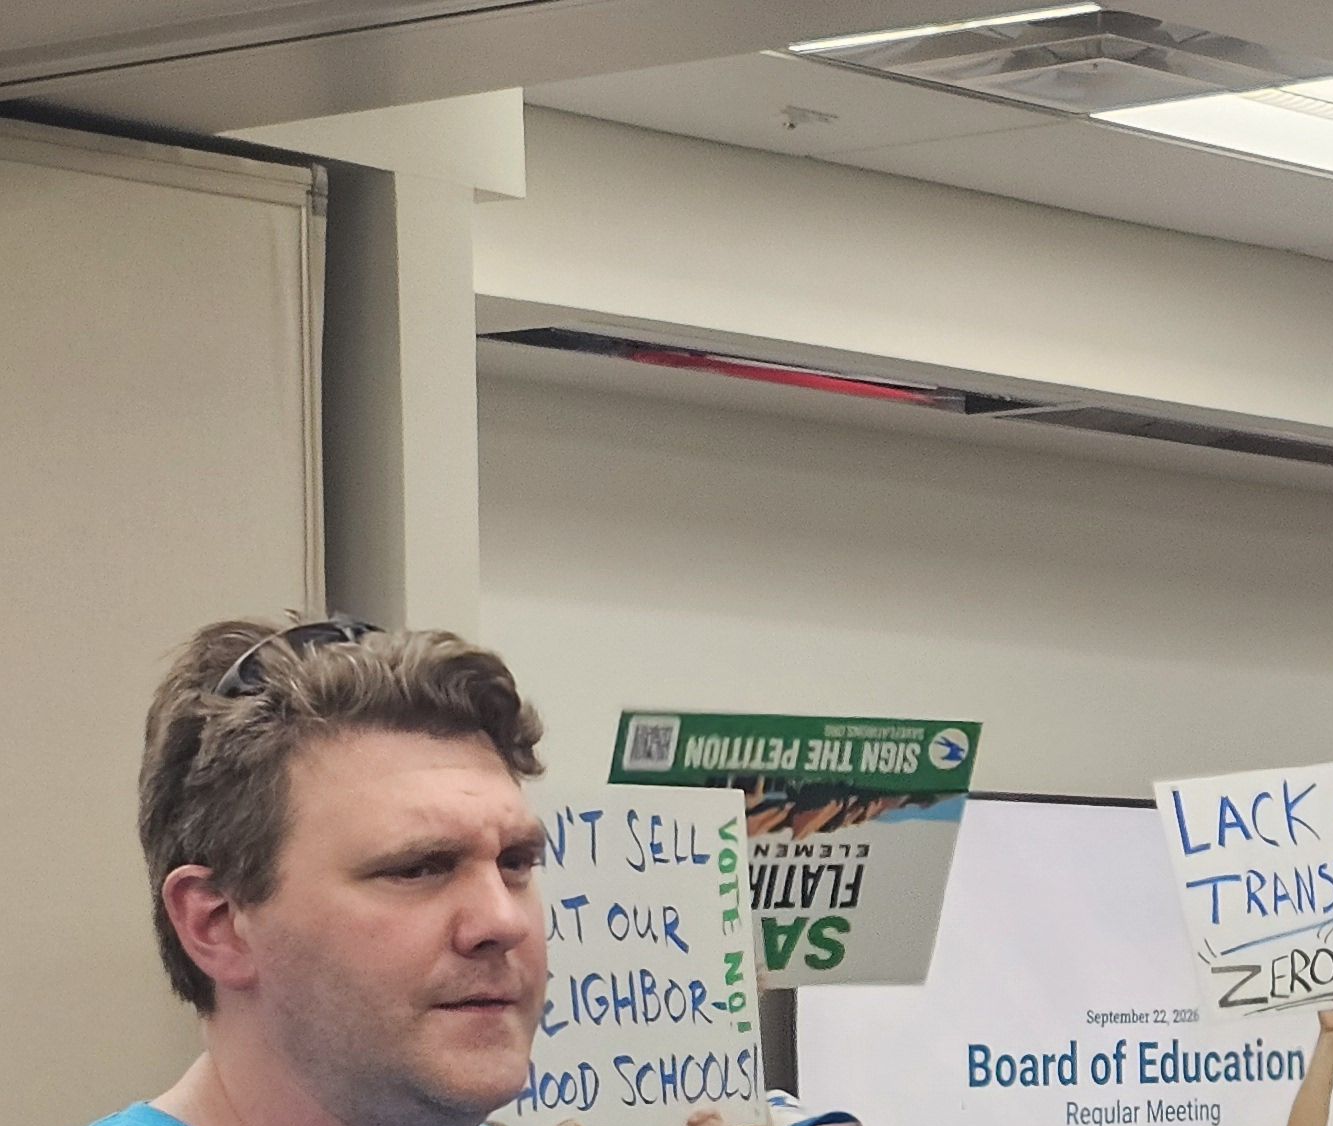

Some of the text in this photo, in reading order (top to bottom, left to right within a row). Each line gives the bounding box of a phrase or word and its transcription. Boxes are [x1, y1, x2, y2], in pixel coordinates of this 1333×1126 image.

[682, 734, 922, 775] SIGN THE PETITION
[544, 805, 711, 873] N'T SELL
[1171, 778, 1322, 857] LACK
[717, 815, 741, 937] VOTE
[752, 843, 871, 860] ELEMEN
[547, 893, 690, 955] UT OUR
[761, 914, 852, 972] SA
[539, 968, 728, 1038] EIGHBOR-
[1086, 1008, 1151, 1028] September
[1152, 1008, 1170, 1026] 22,
[967, 1037, 1306, 1089] Board of Education
[1145, 1098, 1222, 1126] Meeting
